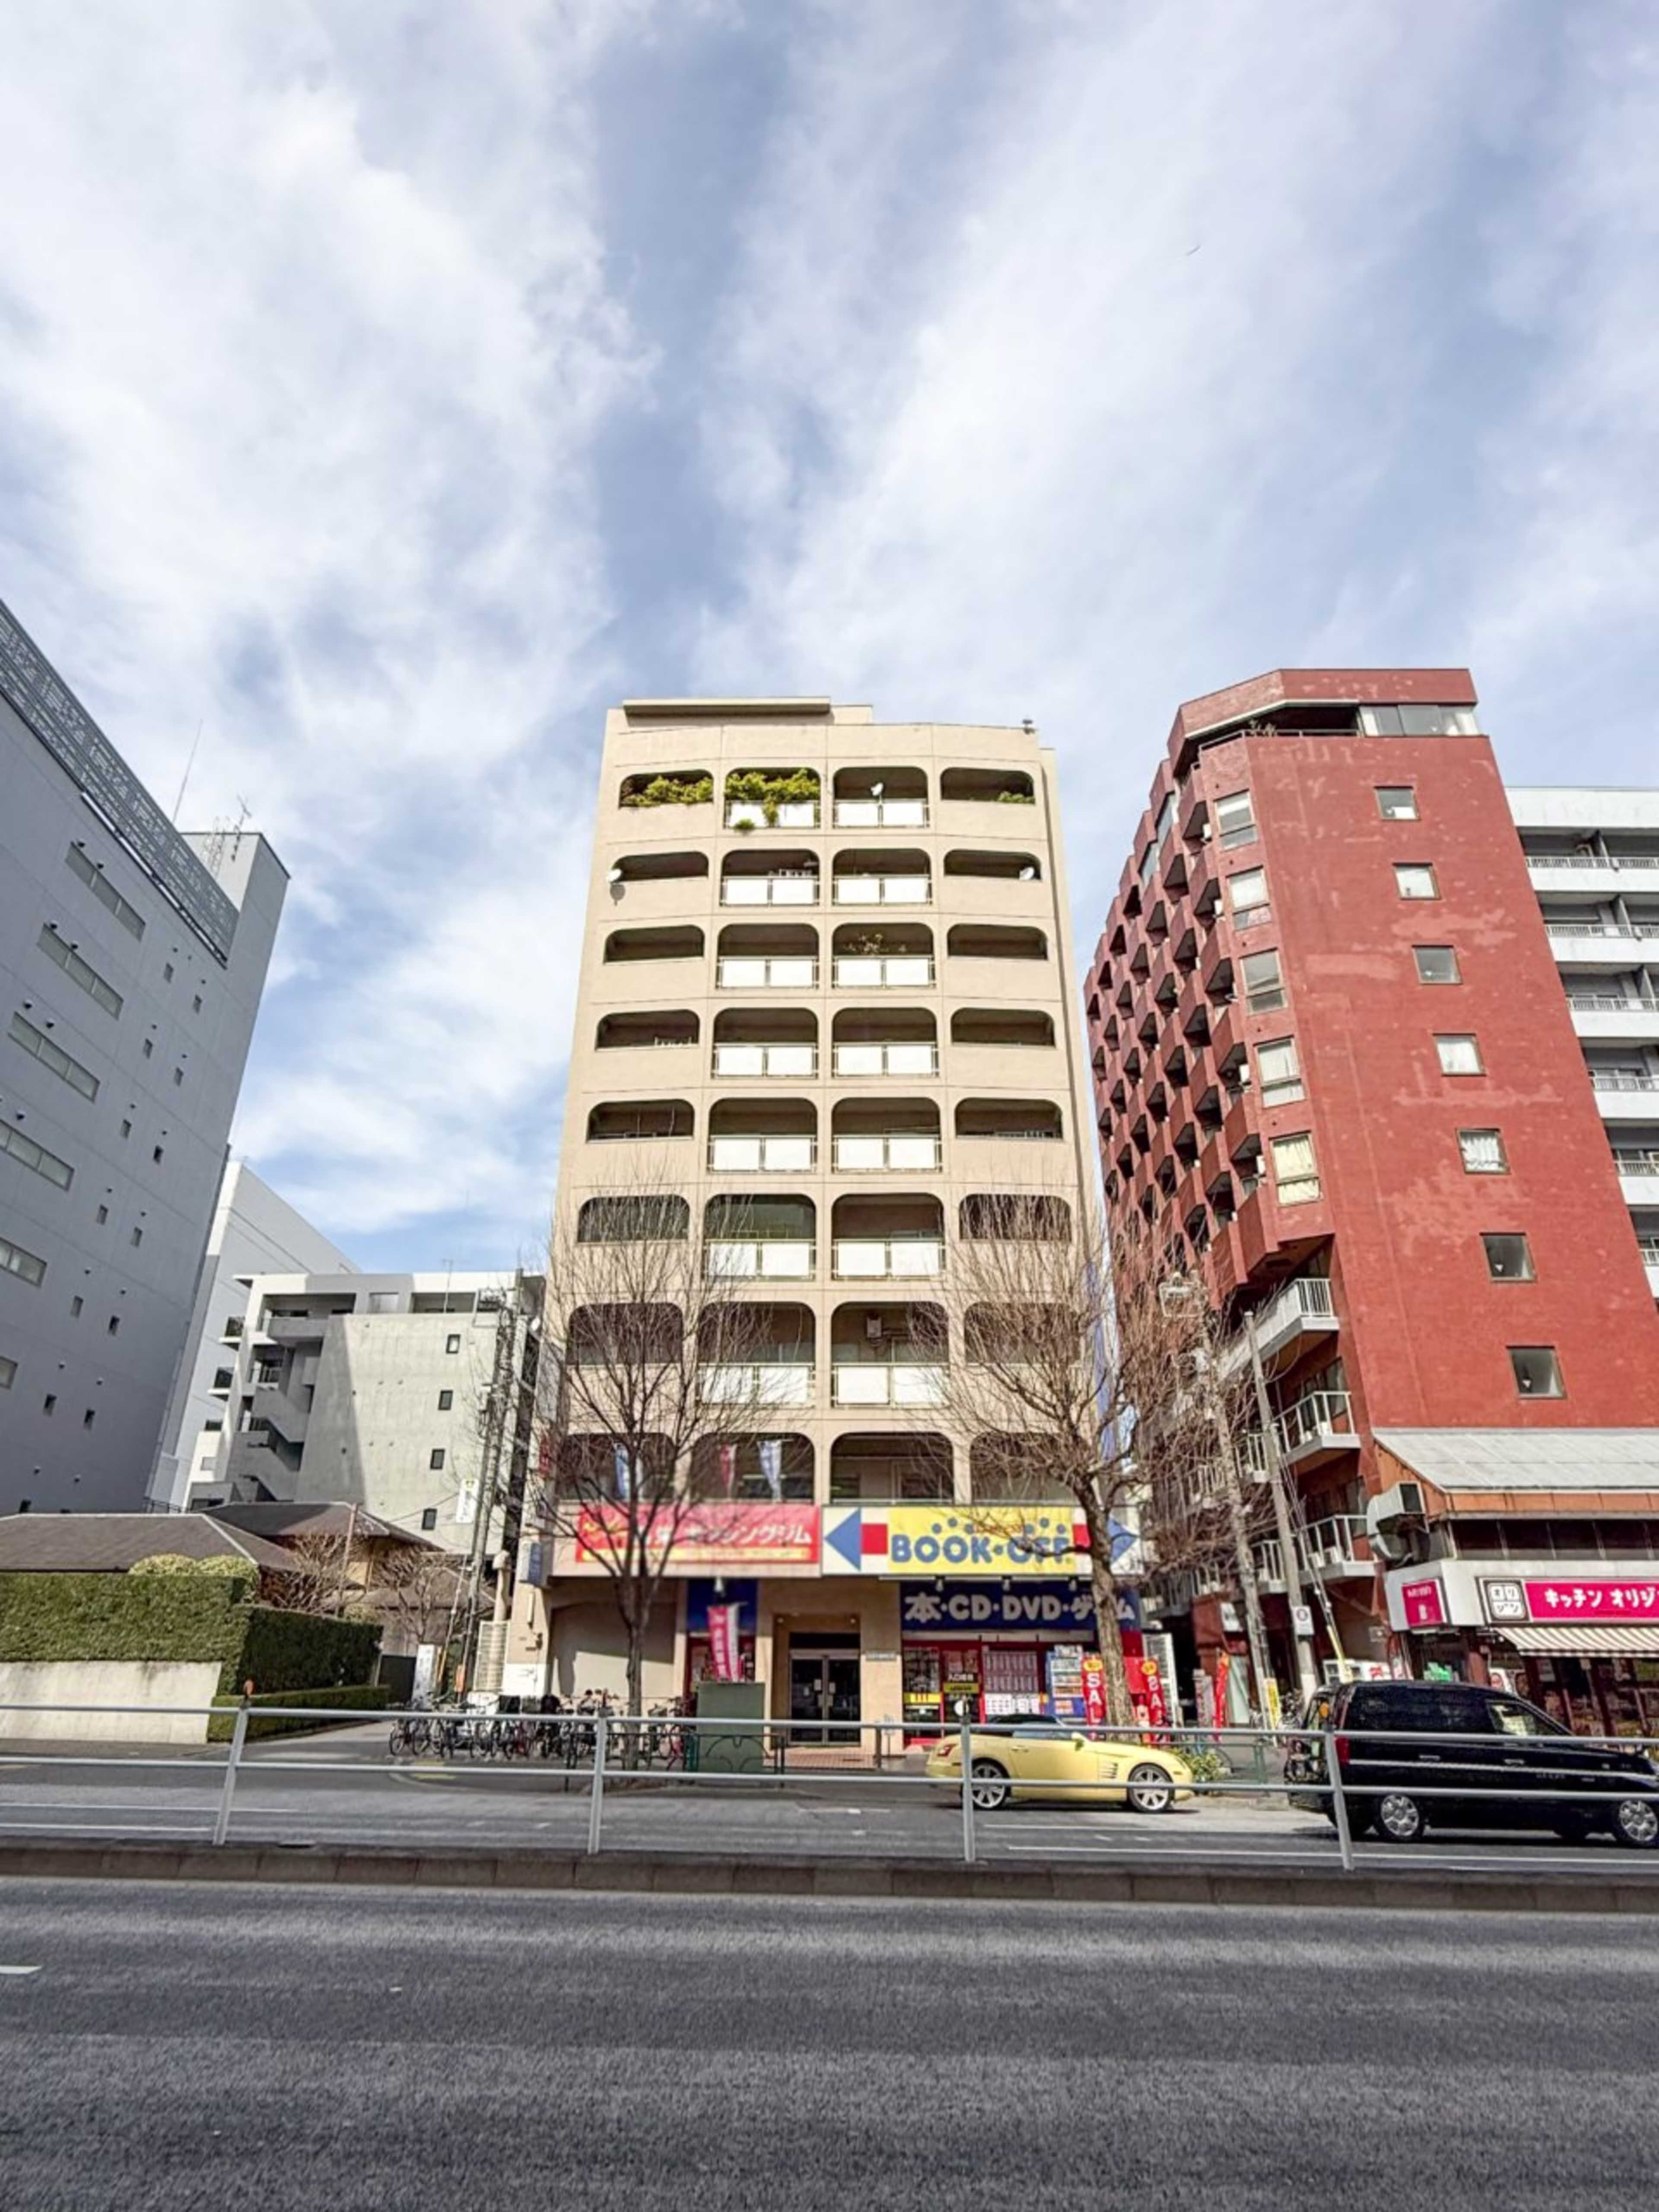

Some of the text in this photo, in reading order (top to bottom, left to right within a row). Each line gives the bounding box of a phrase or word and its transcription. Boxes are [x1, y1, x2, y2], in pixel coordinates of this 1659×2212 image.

[905, 1592, 1135, 1623] 本・CD・DVD・ゲム
[1545, 1587, 1659, 1608] キッチン オリジ
